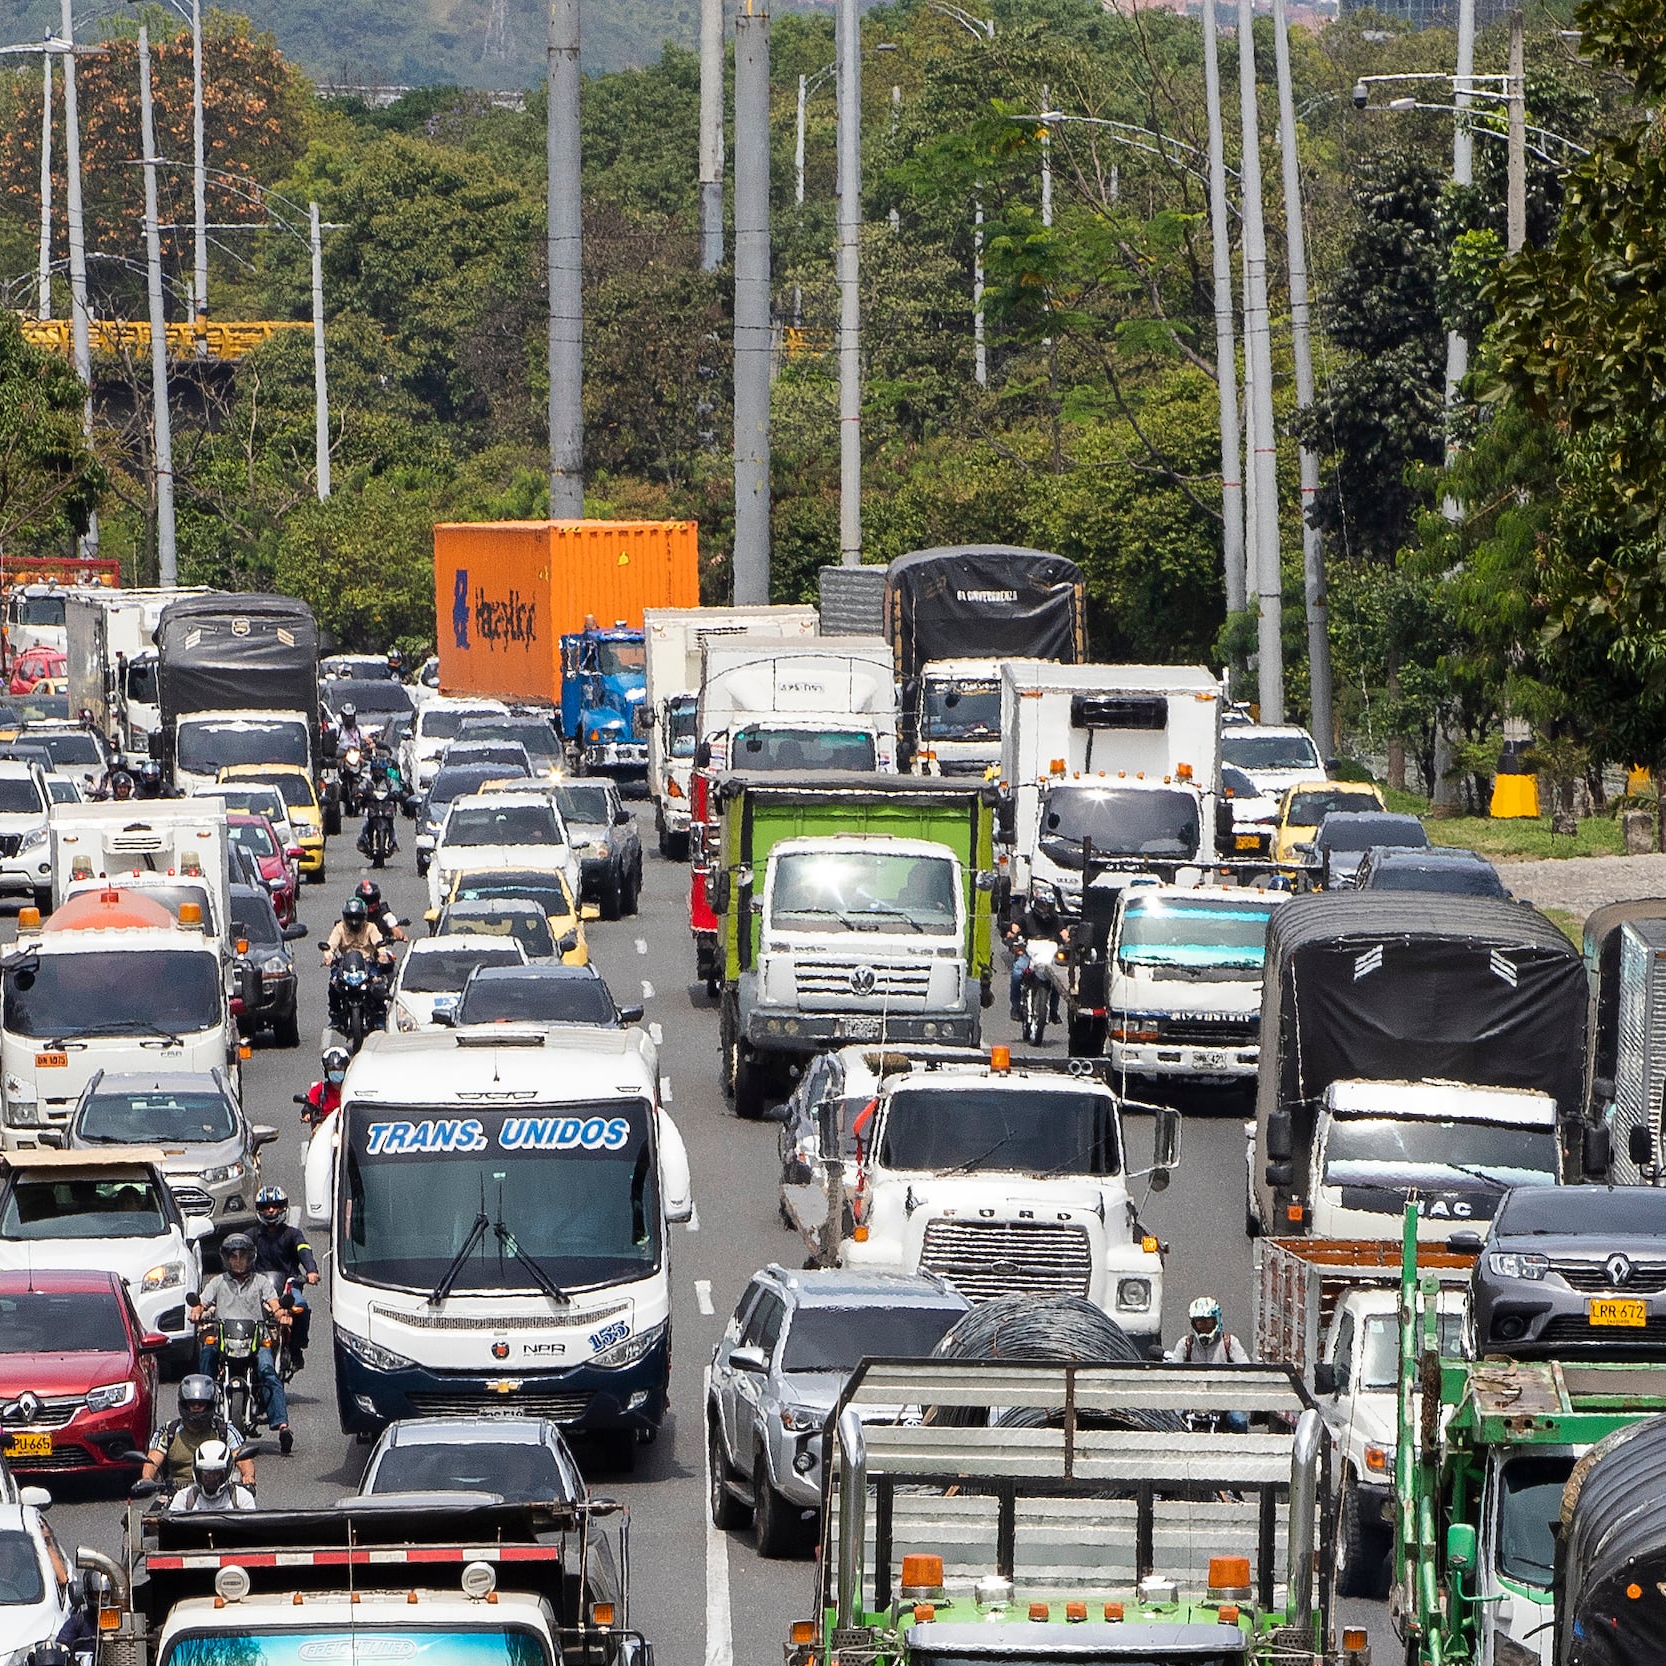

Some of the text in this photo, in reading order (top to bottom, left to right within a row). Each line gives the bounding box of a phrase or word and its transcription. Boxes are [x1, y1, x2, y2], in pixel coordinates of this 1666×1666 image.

[366, 1116, 631, 1155] TRANS. UNIDOS
[943, 1208, 1072, 1220] FORD
[587, 1320, 631, 1353] 155
[523, 1344, 566, 1353] NPR
